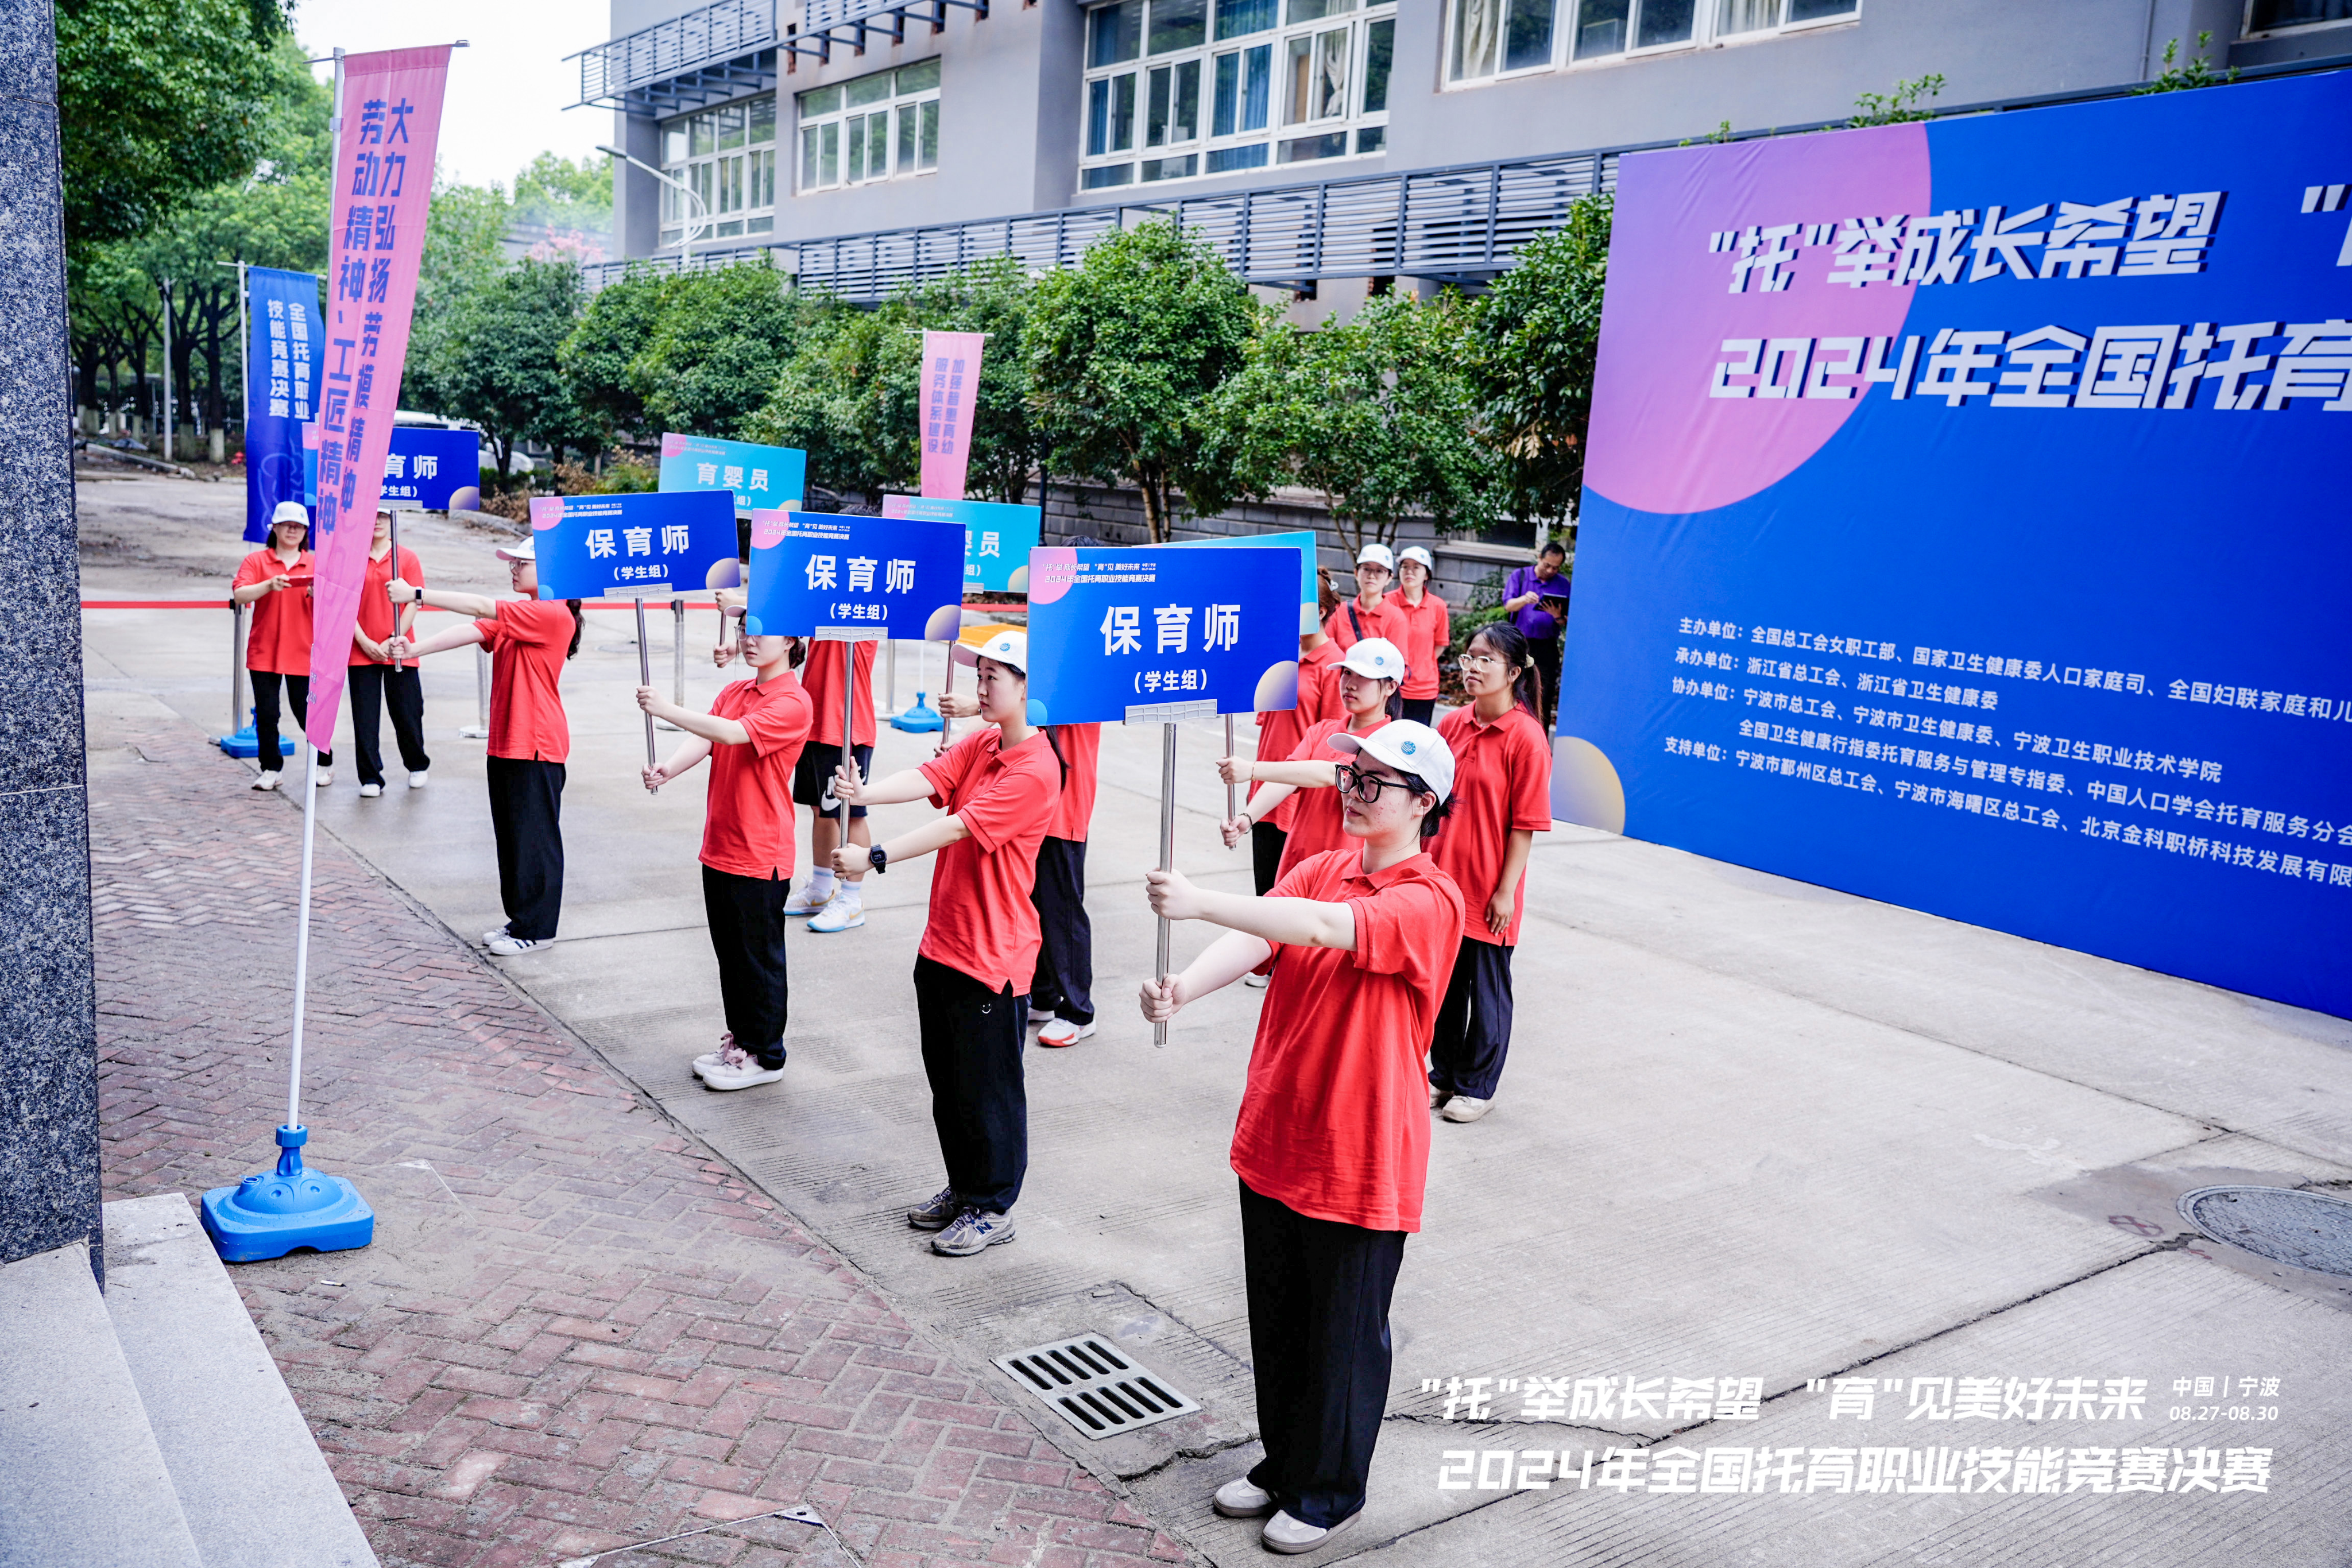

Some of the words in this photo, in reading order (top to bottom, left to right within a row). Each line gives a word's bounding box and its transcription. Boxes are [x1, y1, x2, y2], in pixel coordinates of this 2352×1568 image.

[317, 99, 387, 535] 劳动精神、工匠精神
[341, 98, 413, 513] 大力弘扬劳模精神
[268, 299, 289, 418] 技能竞赛决赛
[288, 303, 311, 420] 全国托育职业
[1708, 319, 2352, 412] 2024年全国托育
[928, 358, 949, 454] 服务体系建设
[941, 359, 965, 455] 加强普惠育幼
[697, 462, 768, 492] 育婴员
[585, 525, 690, 559] 保育师
[614, 564, 668, 580] （学生组）
[805, 554, 916, 594] 保育师
[830, 603, 888, 621] （学生组）
[1100, 603, 1241, 656] 保育师
[1134, 669, 1208, 694] （学生组）
